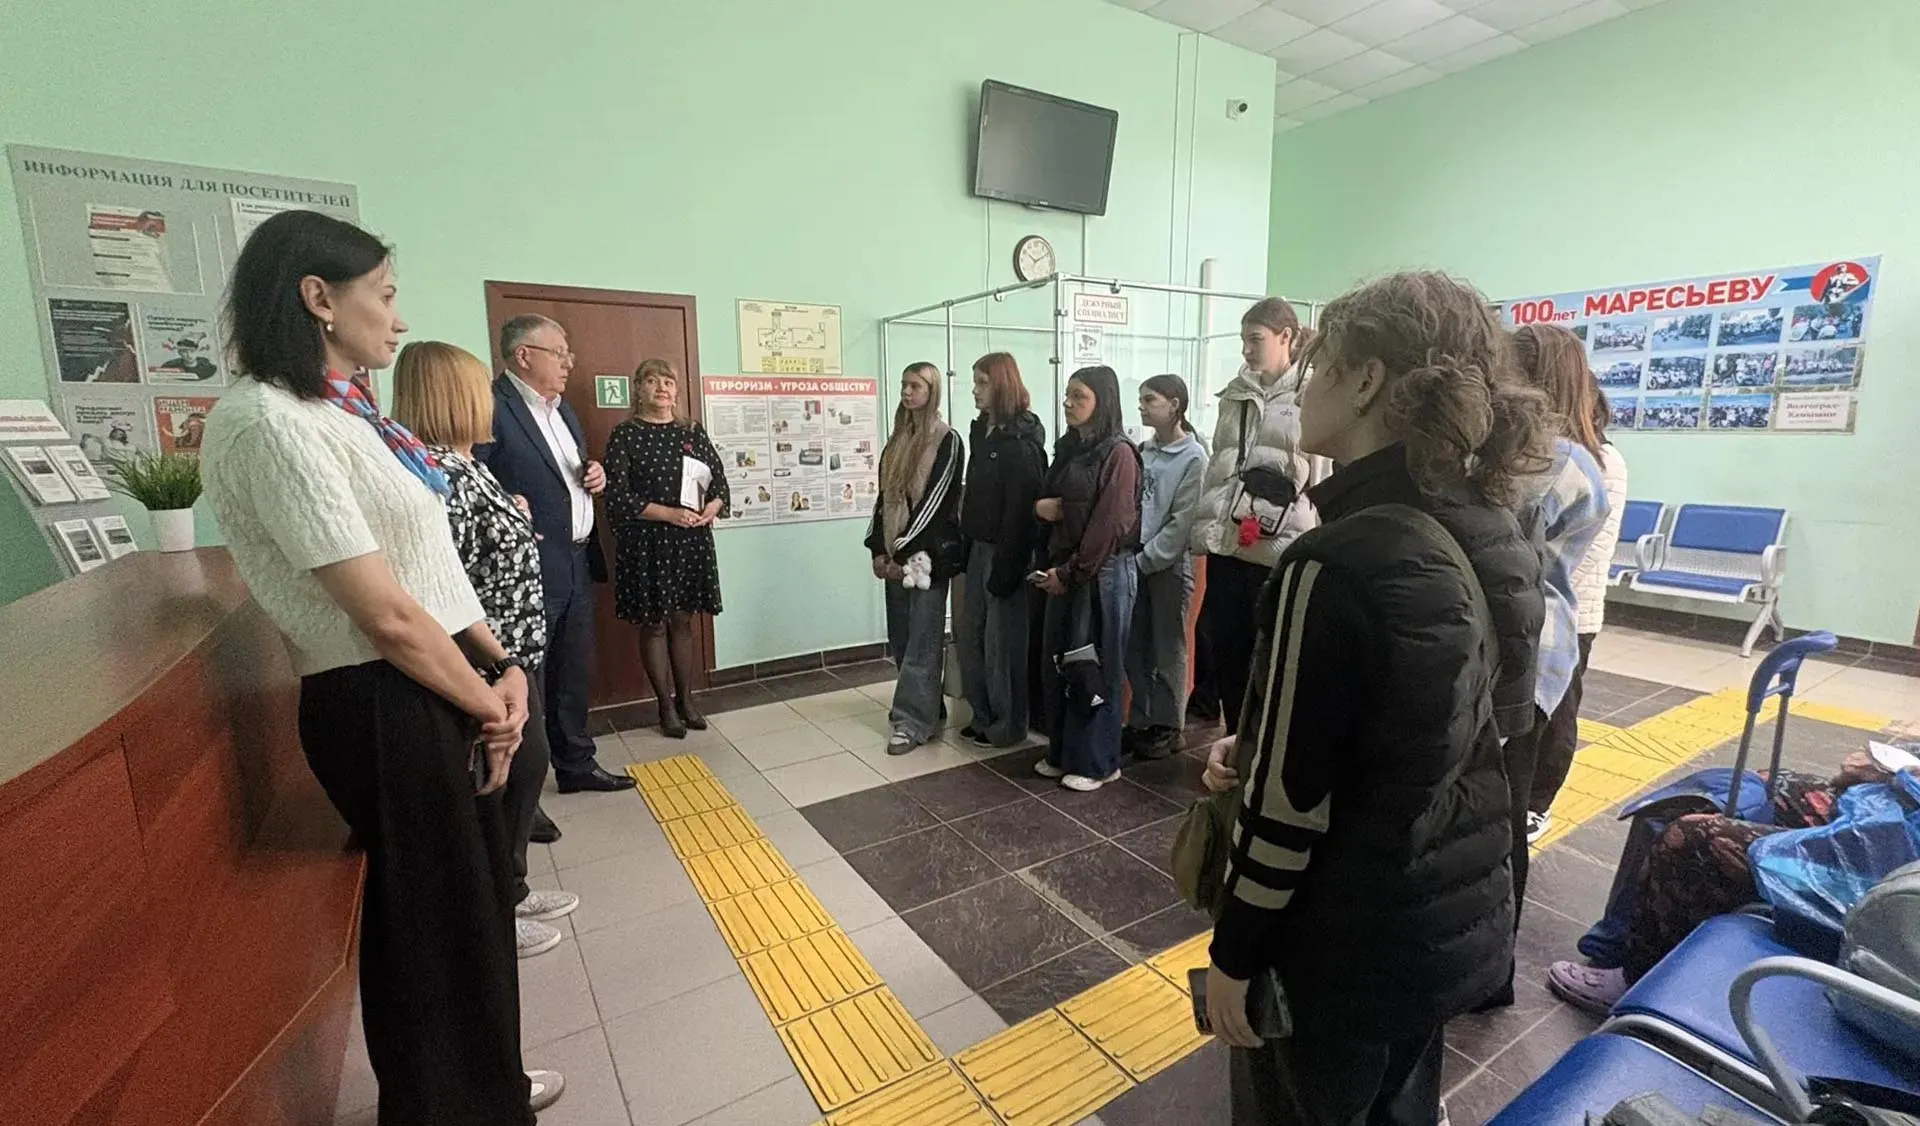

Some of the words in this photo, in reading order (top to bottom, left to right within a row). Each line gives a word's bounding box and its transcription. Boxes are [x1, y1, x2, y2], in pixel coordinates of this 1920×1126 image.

[23, 159, 173, 189] ИНФОРМАЦИЯ
[180, 178, 218, 194] ДЛЯ
[222, 182, 351, 208] ПОСЕТИТЕЛЕЙ
[1584, 275, 1775, 317] МАРЕСЬЕВУ
[709, 380, 773, 391] ТЕРРОРИЗМ
[780, 380, 819, 392] УГРОЗА
[820, 381, 872, 393] ОБЩЕСТВУ
